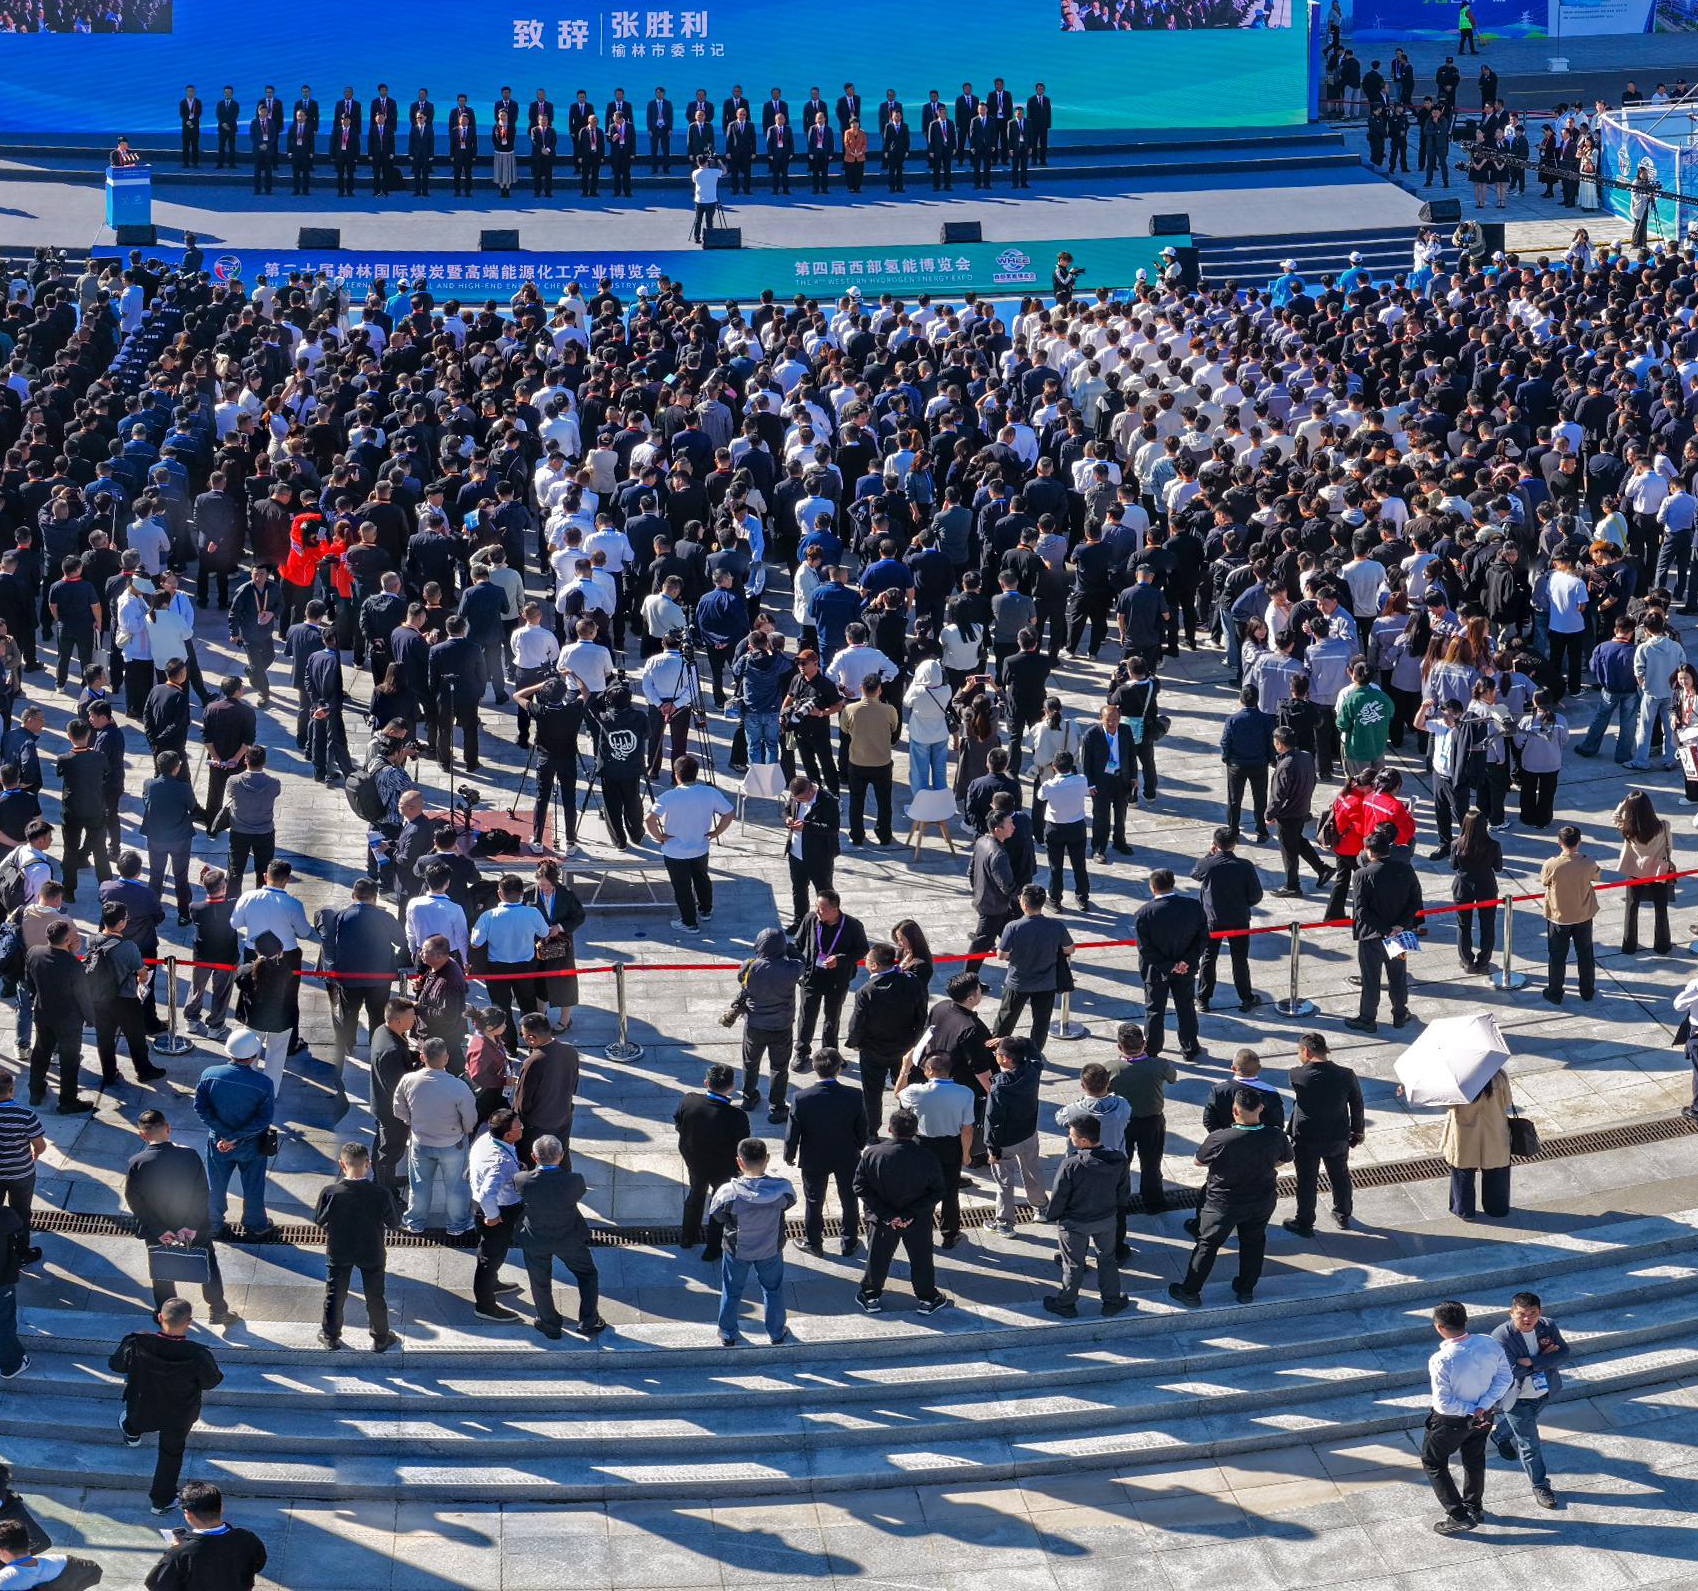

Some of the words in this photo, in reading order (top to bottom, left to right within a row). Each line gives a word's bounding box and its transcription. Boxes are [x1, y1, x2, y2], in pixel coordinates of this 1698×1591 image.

[611, 10, 709, 39] 张胜利
[511, 18, 590, 51] 致辞
[611, 42, 726, 58] 榆林市委书记
[263, 261, 663, 280] 第二十届榆林国际煤炭暨高端能源化工产业博览会
[794, 256, 973, 278] 第四届西部氢能博览会
[995, 256, 1031, 266] WHEE
[828, 276, 867, 286] WESTERN
[869, 275, 915, 285] HYDROGEN
[917, 275, 949, 283] ENERGY
[951, 274, 974, 282] EXPO
